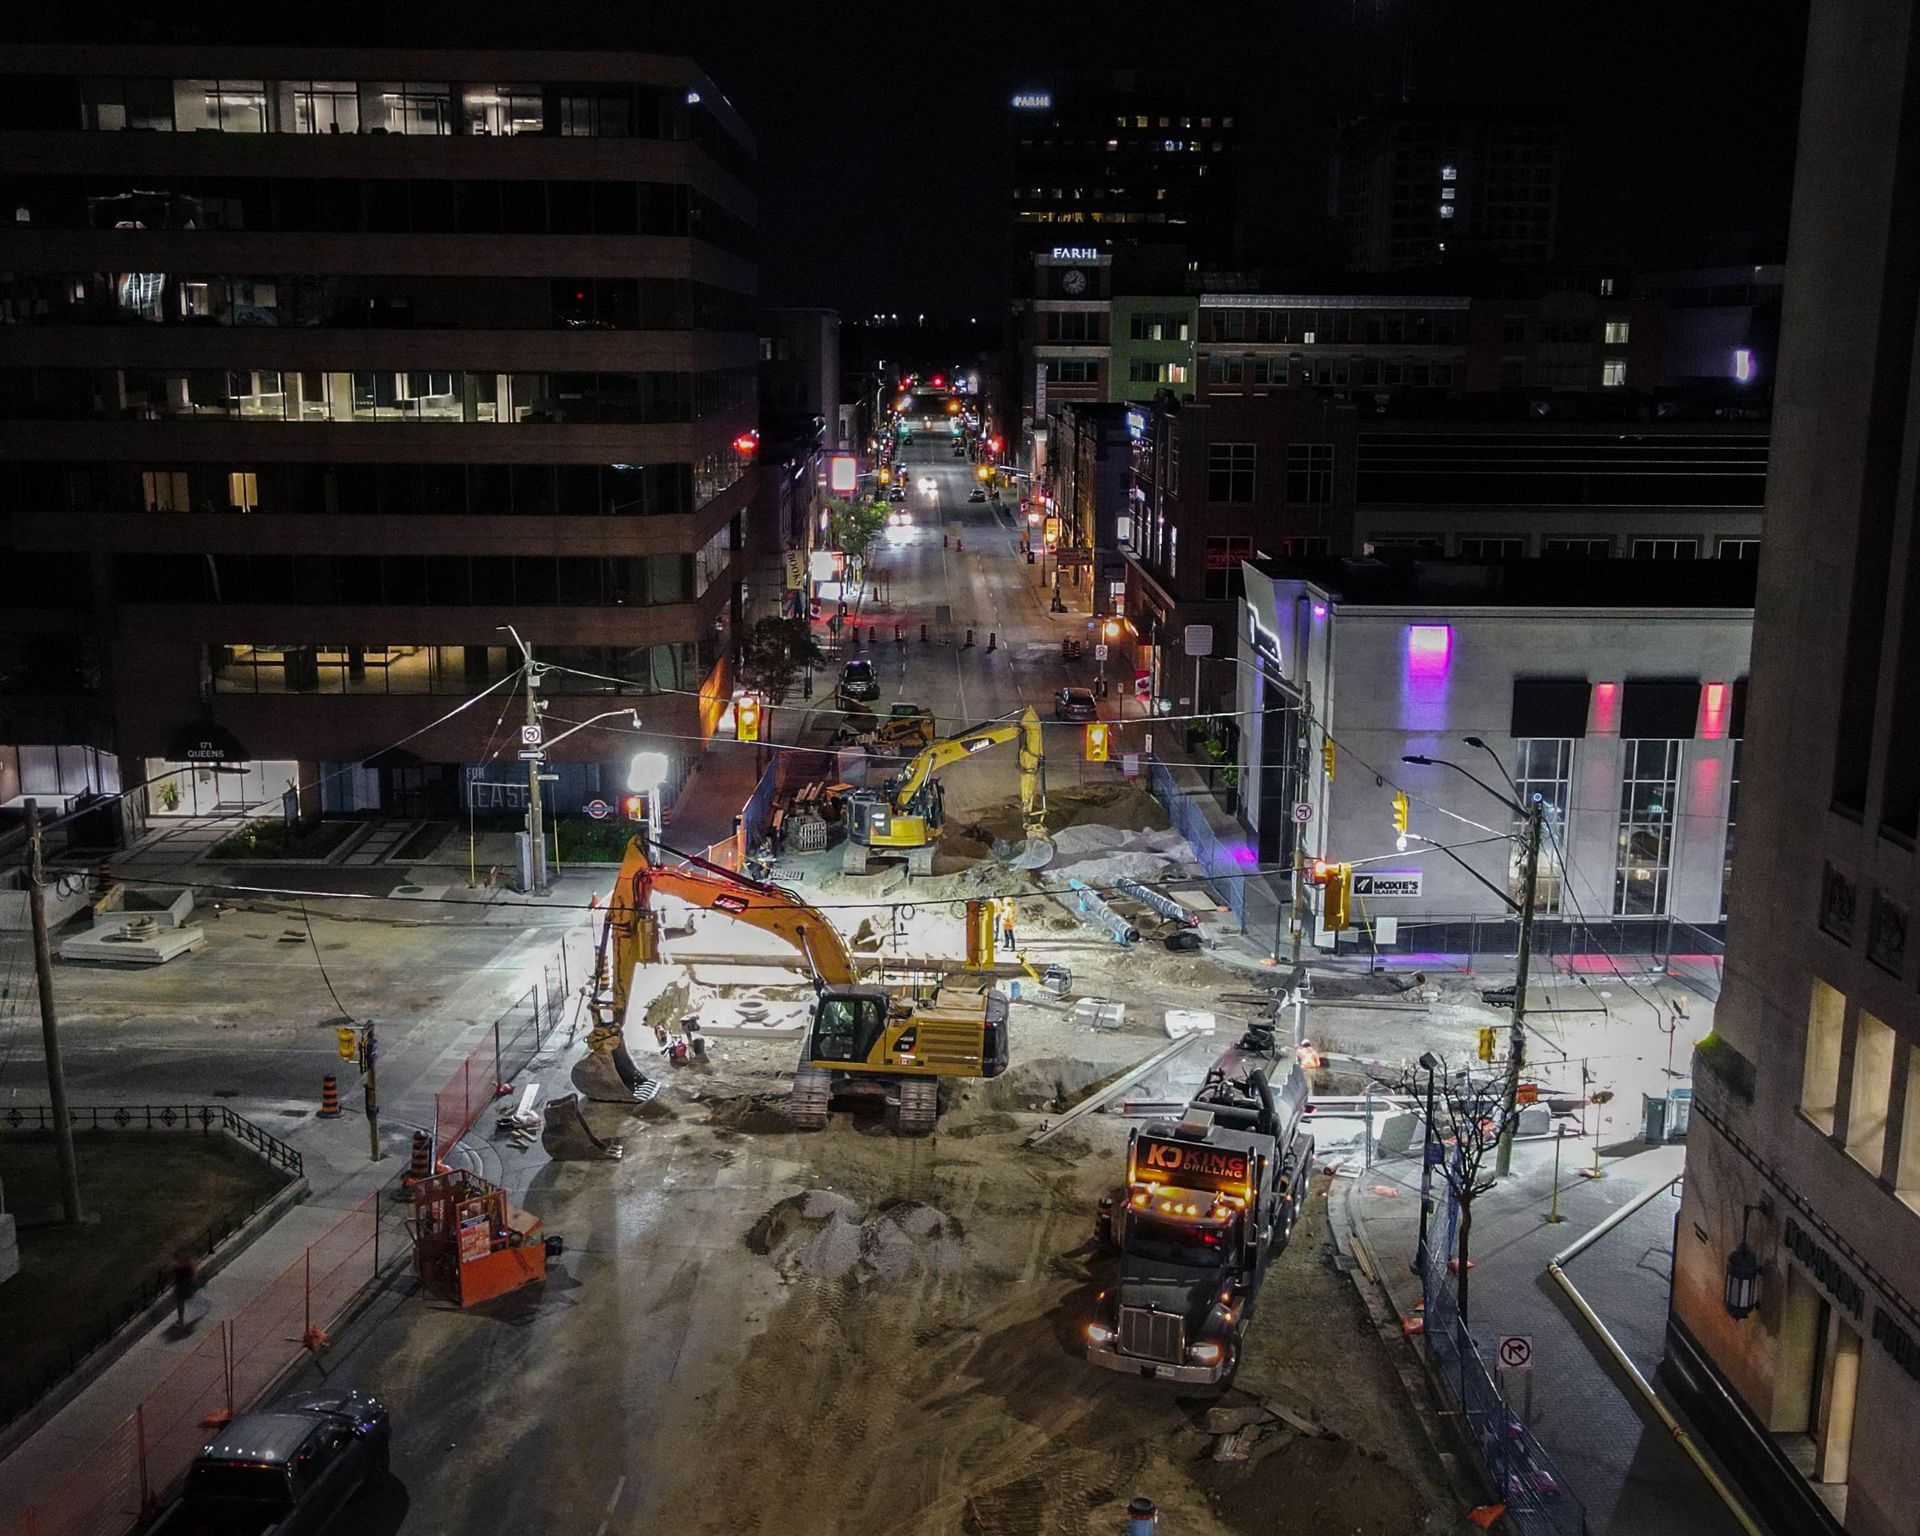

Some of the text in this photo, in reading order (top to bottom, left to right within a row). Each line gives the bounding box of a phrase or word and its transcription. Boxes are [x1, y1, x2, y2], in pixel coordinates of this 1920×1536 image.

[1053, 247, 1098, 259] FARHI
[787, 552, 802, 586] BOOKS
[199, 741, 213, 750] 171
[186, 749, 225, 759] QUEENS
[465, 767, 485, 779] FOR
[466, 780, 530, 809] LEASE
[1373, 880, 1419, 890] MOXIE'S
[1184, 1150, 1245, 1171] KING
[1183, 1162, 1243, 1179] DRILLING
